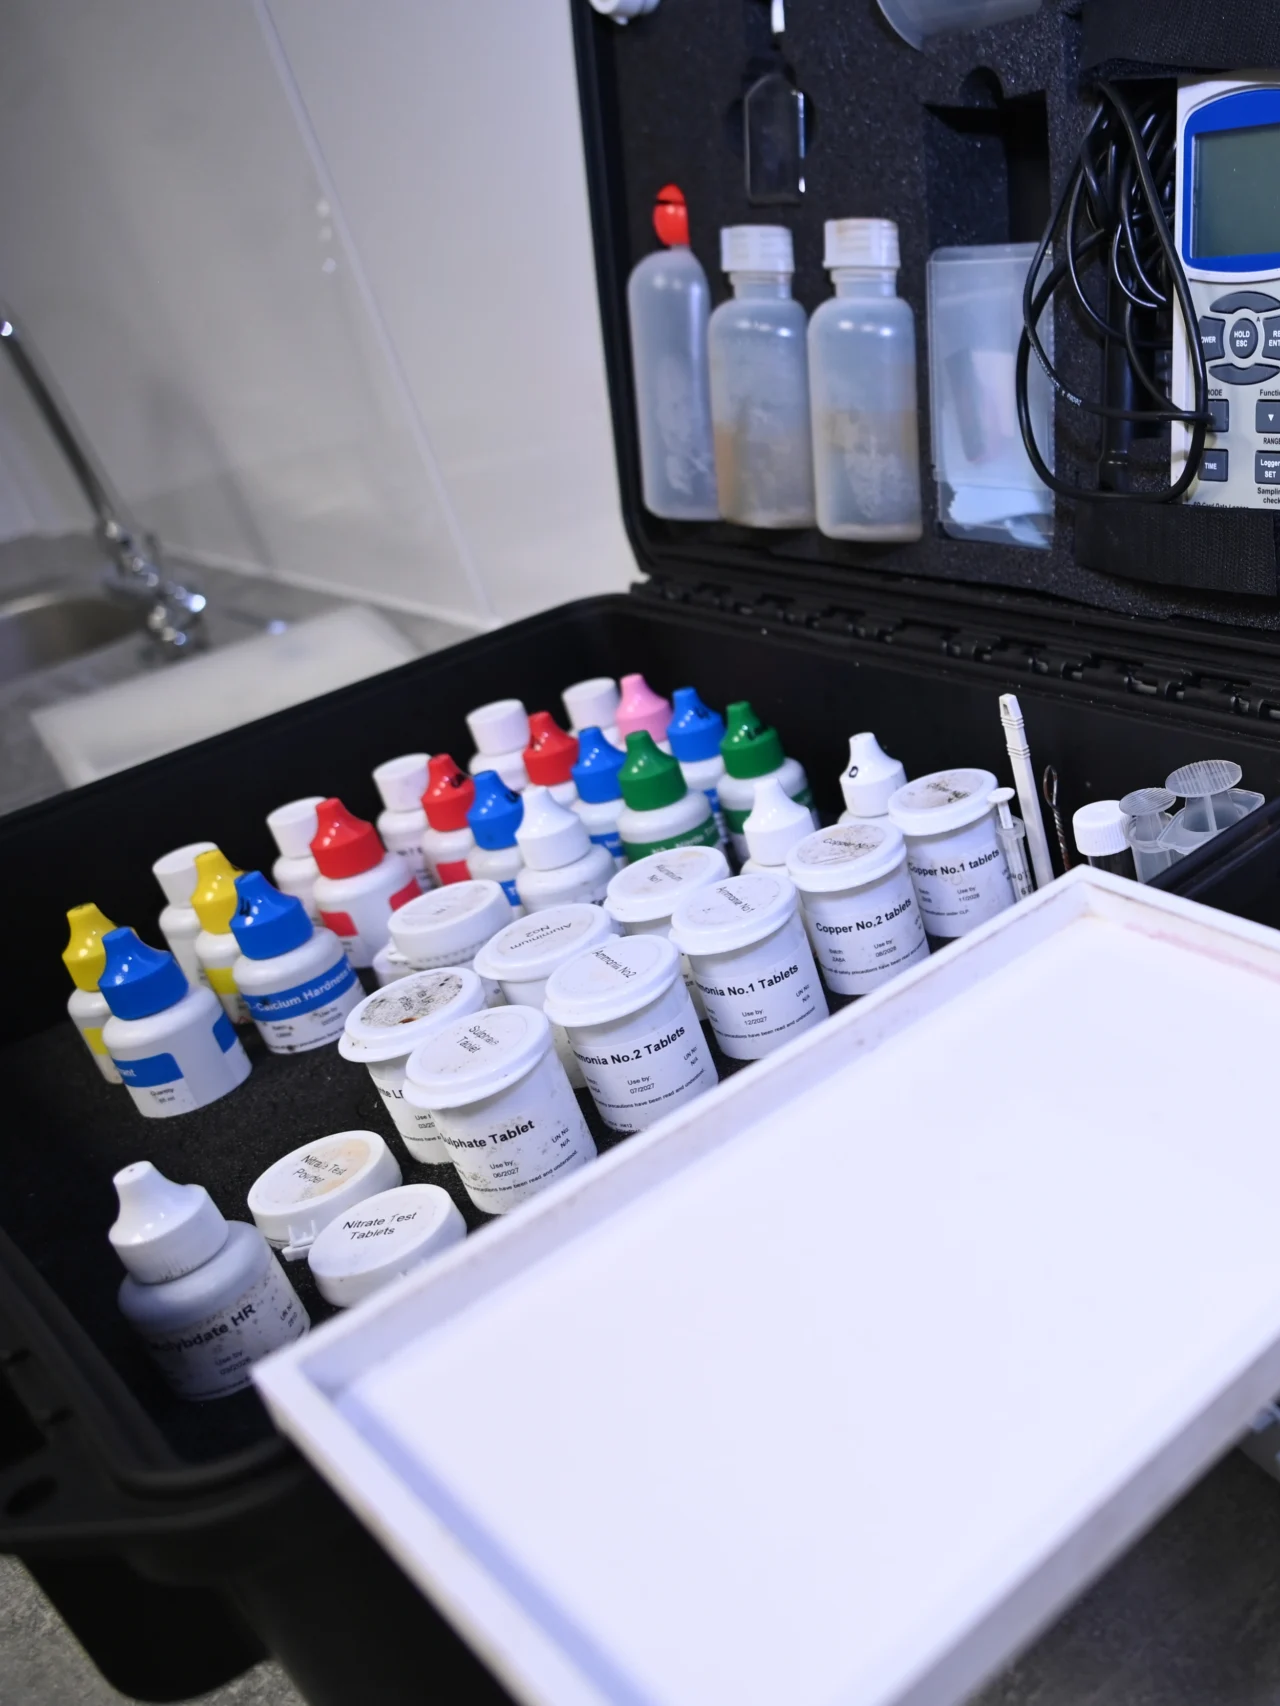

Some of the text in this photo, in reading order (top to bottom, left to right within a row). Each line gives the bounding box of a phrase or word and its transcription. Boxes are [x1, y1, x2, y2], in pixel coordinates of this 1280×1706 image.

[1260, 459, 1280, 468] Logger
[908, 849, 1000, 876] Copper No.1 tablets
[717, 886, 742, 906] Ammonia
[816, 922, 852, 935] Copper
[856, 915, 882, 931] No.2
[885, 898, 912, 921] tablets
[510, 922, 572, 950] Aluminium
[525, 925, 550, 938] No2
[592, 949, 636, 979] Ammonia No2
[302, 971, 348, 1000] Hardness
[695, 964, 799, 996] onia No.1 Tablets
[744, 1016, 767, 1026] 12/2027
[456, 1036, 481, 1054] Tablet
[573, 1025, 686, 1065] monia No.2 Tablets
[630, 1083, 655, 1094] 07/2027
[488, 1119, 535, 1144] Tablet
[328, 1163, 348, 1176] Test
[490, 1162, 503, 1170] Use
[493, 1168, 519, 1178] 06/2027
[293, 1168, 326, 1184] Powder
[343, 1212, 417, 1230] Nitrate Test
[350, 1227, 396, 1240] Tablets
[231, 1304, 256, 1327] HR
[215, 1356, 229, 1366] Use
